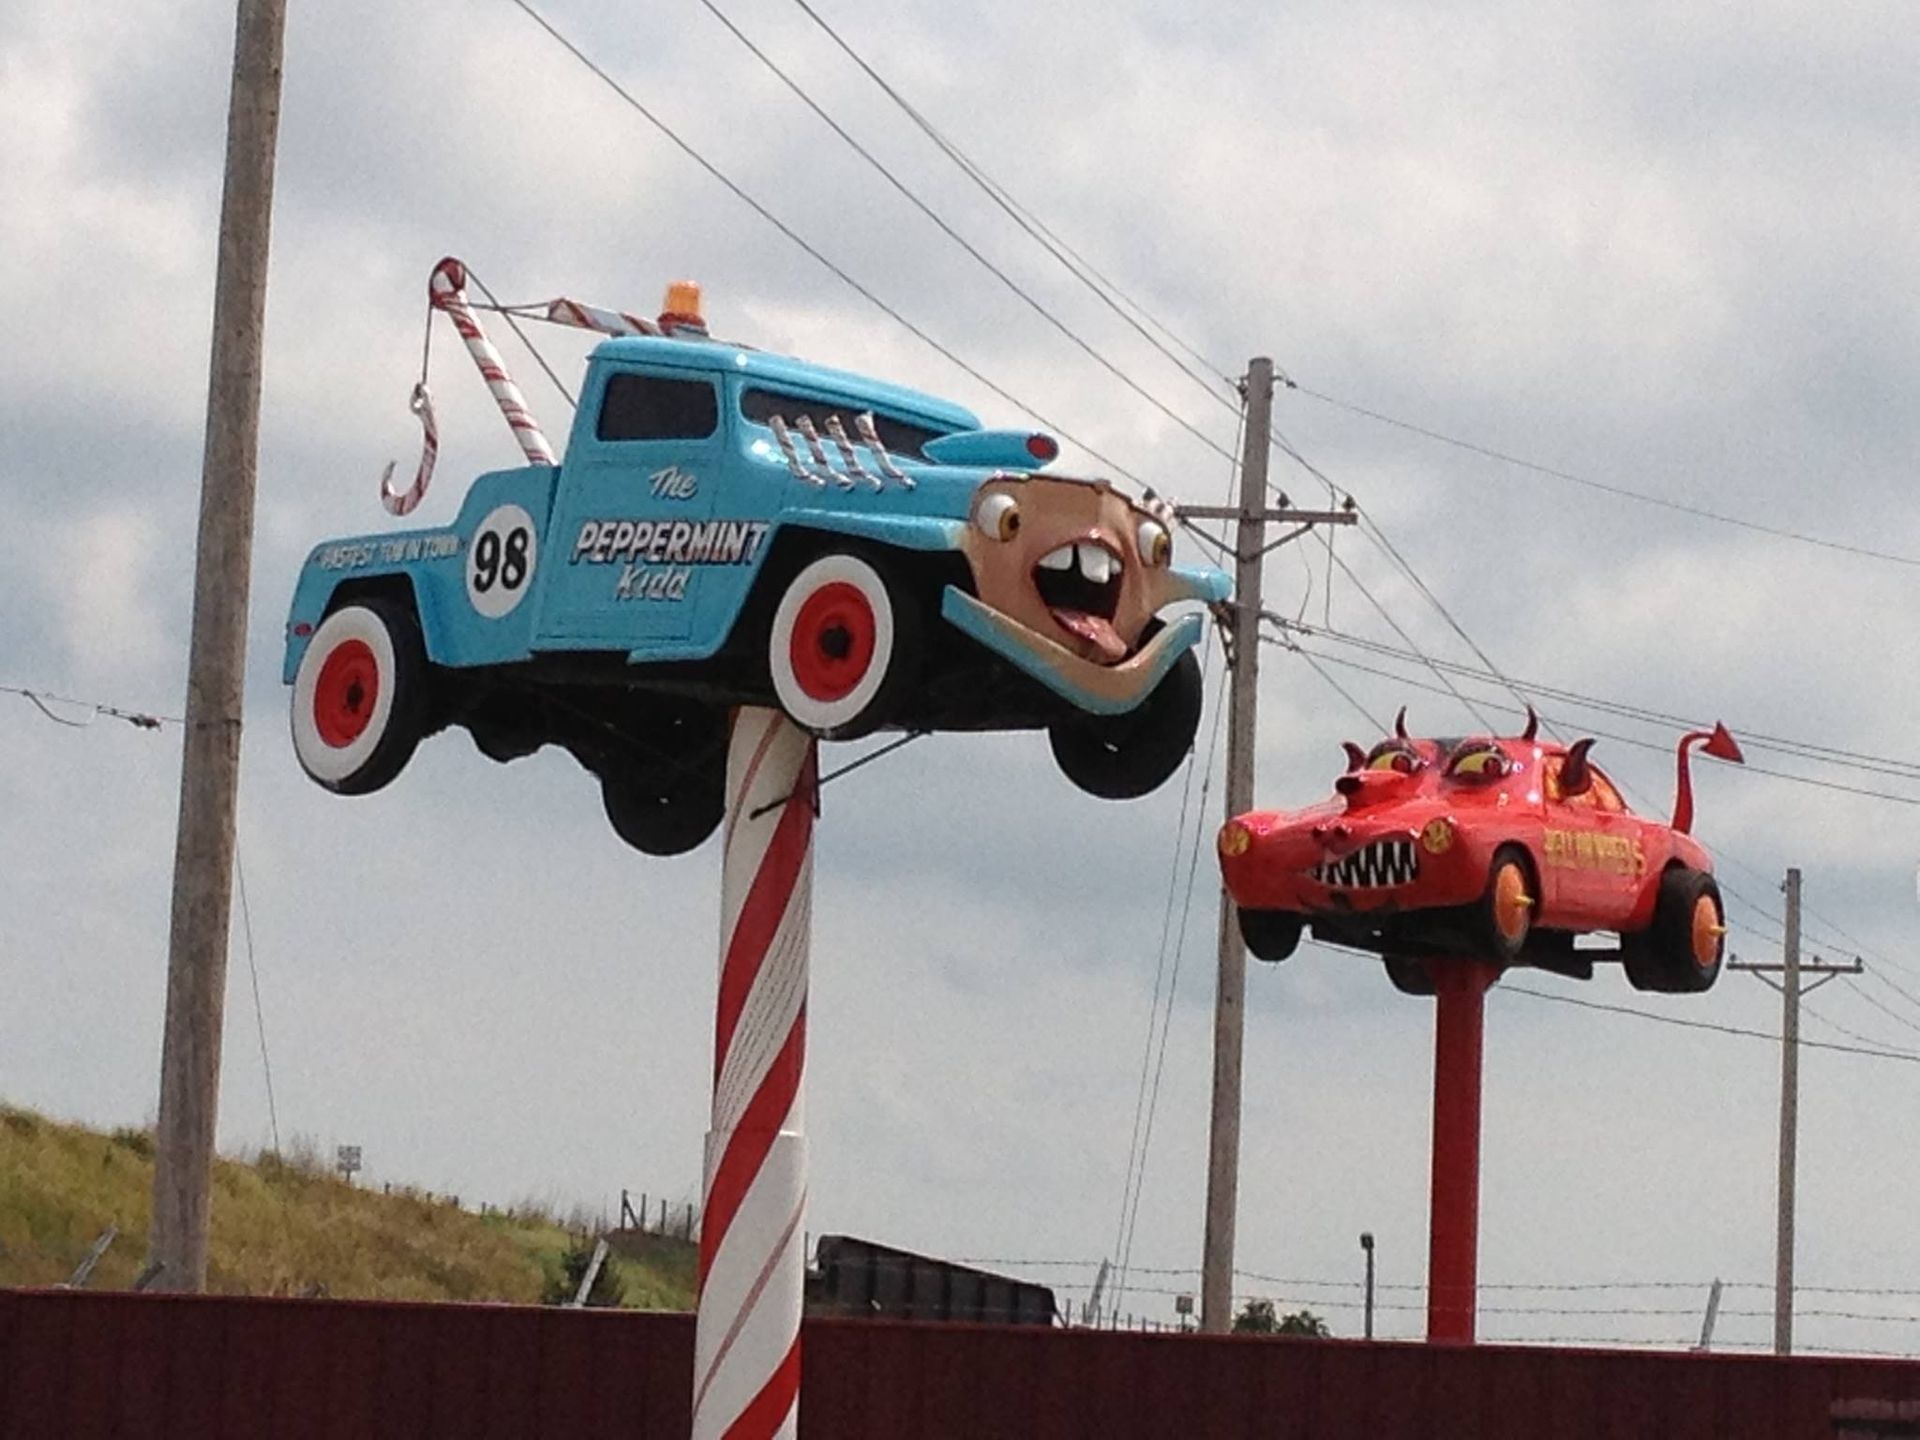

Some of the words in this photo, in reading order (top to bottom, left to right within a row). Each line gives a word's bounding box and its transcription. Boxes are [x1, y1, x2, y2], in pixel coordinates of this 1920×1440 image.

[649, 466, 698, 500] The
[474, 527, 528, 593] 98
[569, 521, 770, 565] PEPPERMINT
[616, 565, 690, 601] Kidd
